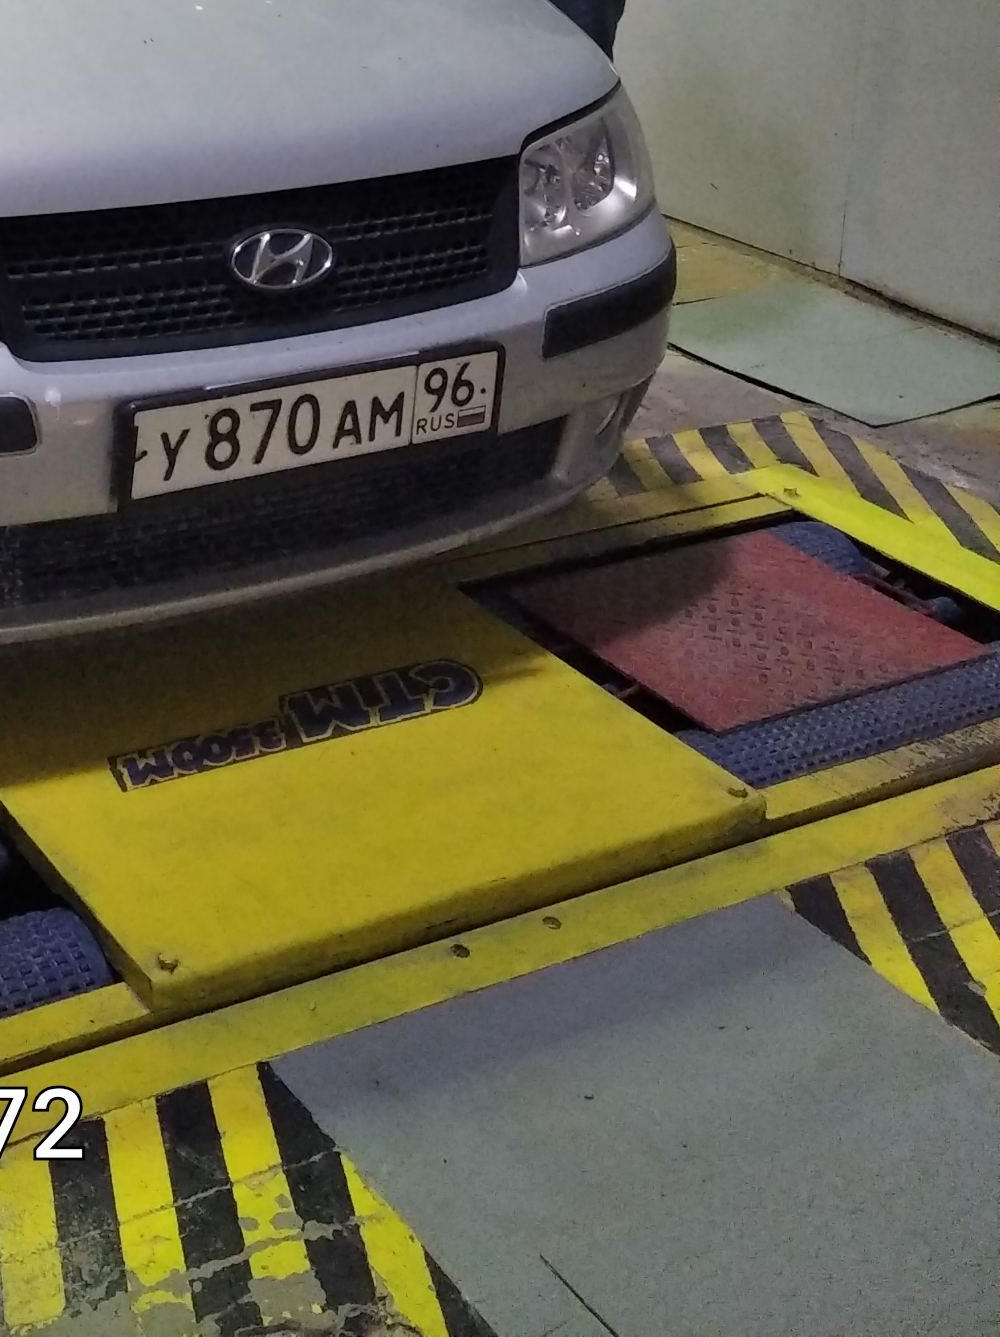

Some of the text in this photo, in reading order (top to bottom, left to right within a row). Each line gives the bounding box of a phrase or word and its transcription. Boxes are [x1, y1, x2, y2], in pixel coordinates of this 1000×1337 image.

[159, 362, 475, 482] У870АМ 96
[415, 413, 456, 435] RUS
[281, 659, 483, 745] СТМ
